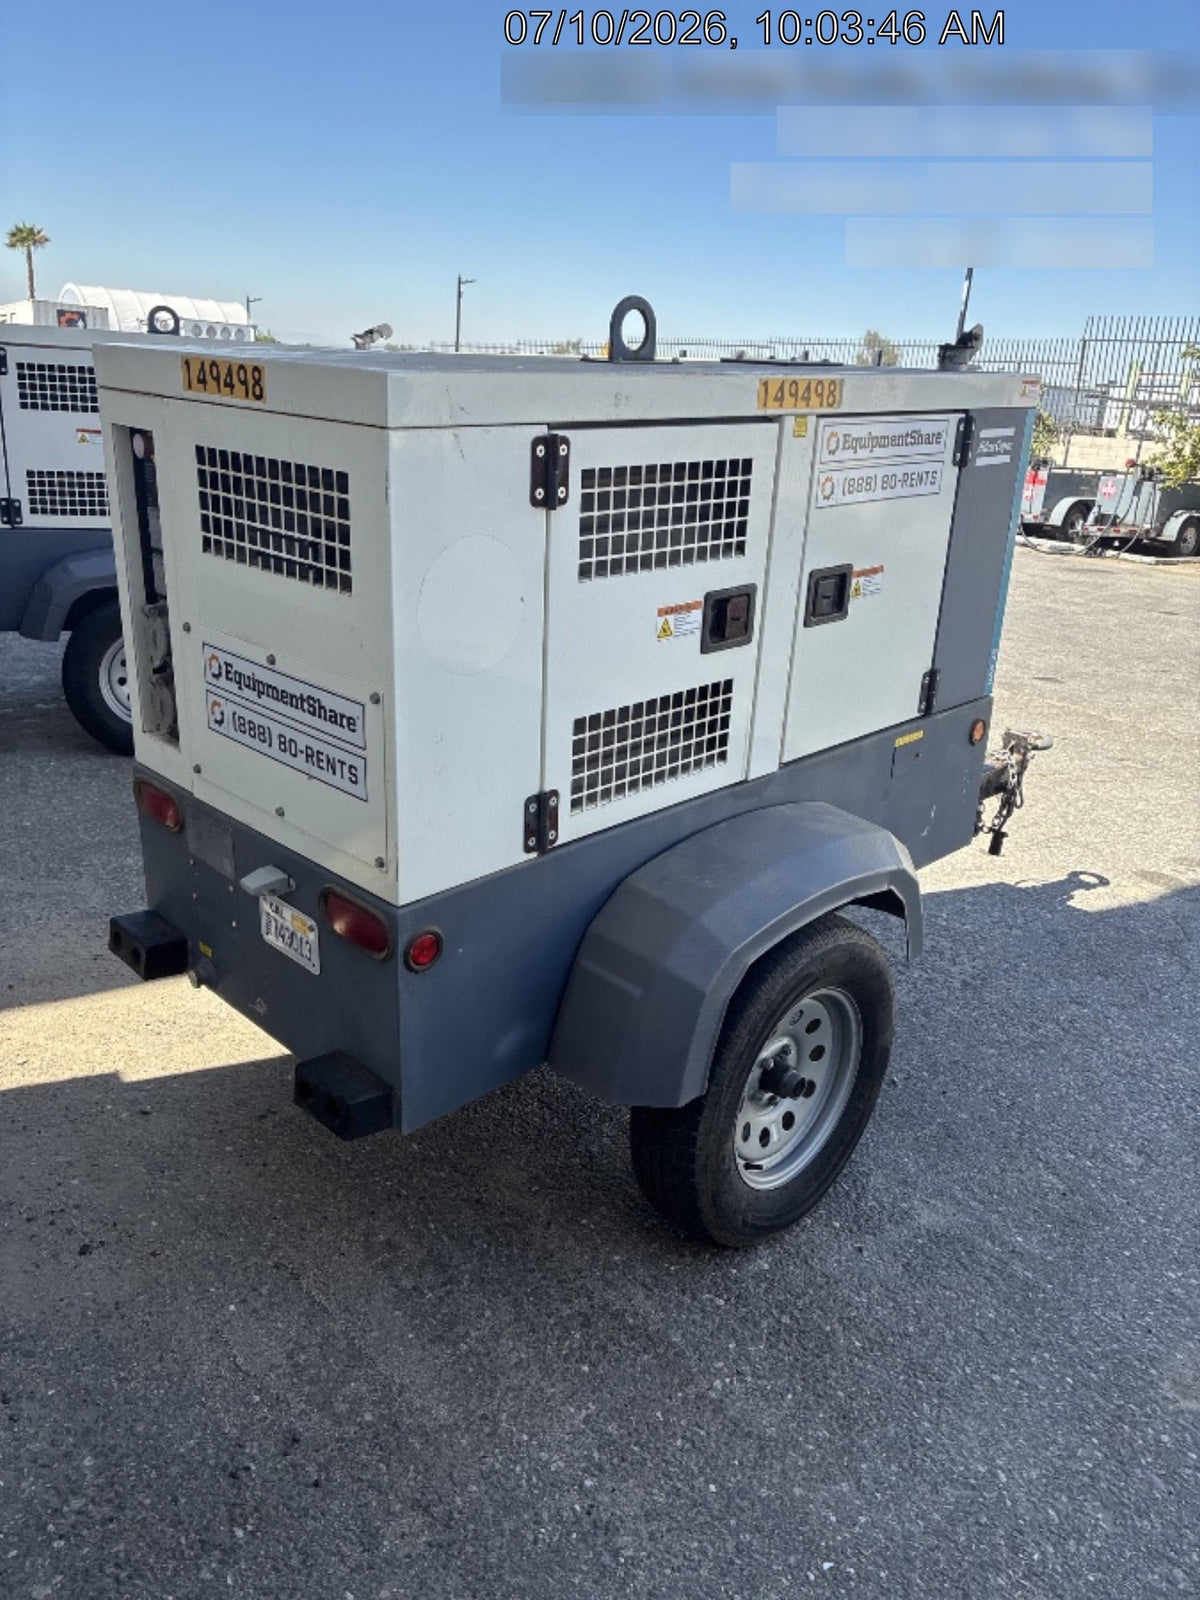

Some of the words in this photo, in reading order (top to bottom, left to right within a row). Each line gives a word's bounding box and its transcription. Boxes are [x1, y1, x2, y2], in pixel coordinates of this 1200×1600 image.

[184, 358, 264, 401] 149498
[762, 379, 837, 408] 149498
[841, 430, 942, 454] EquipmentShare
[842, 474, 878, 497] (888)
[881, 470, 938, 491] 80-RENTS
[223, 661, 357, 734] EquipmentShare
[231, 710, 273, 748] (888)
[277, 733, 359, 785] 80-RENTS
